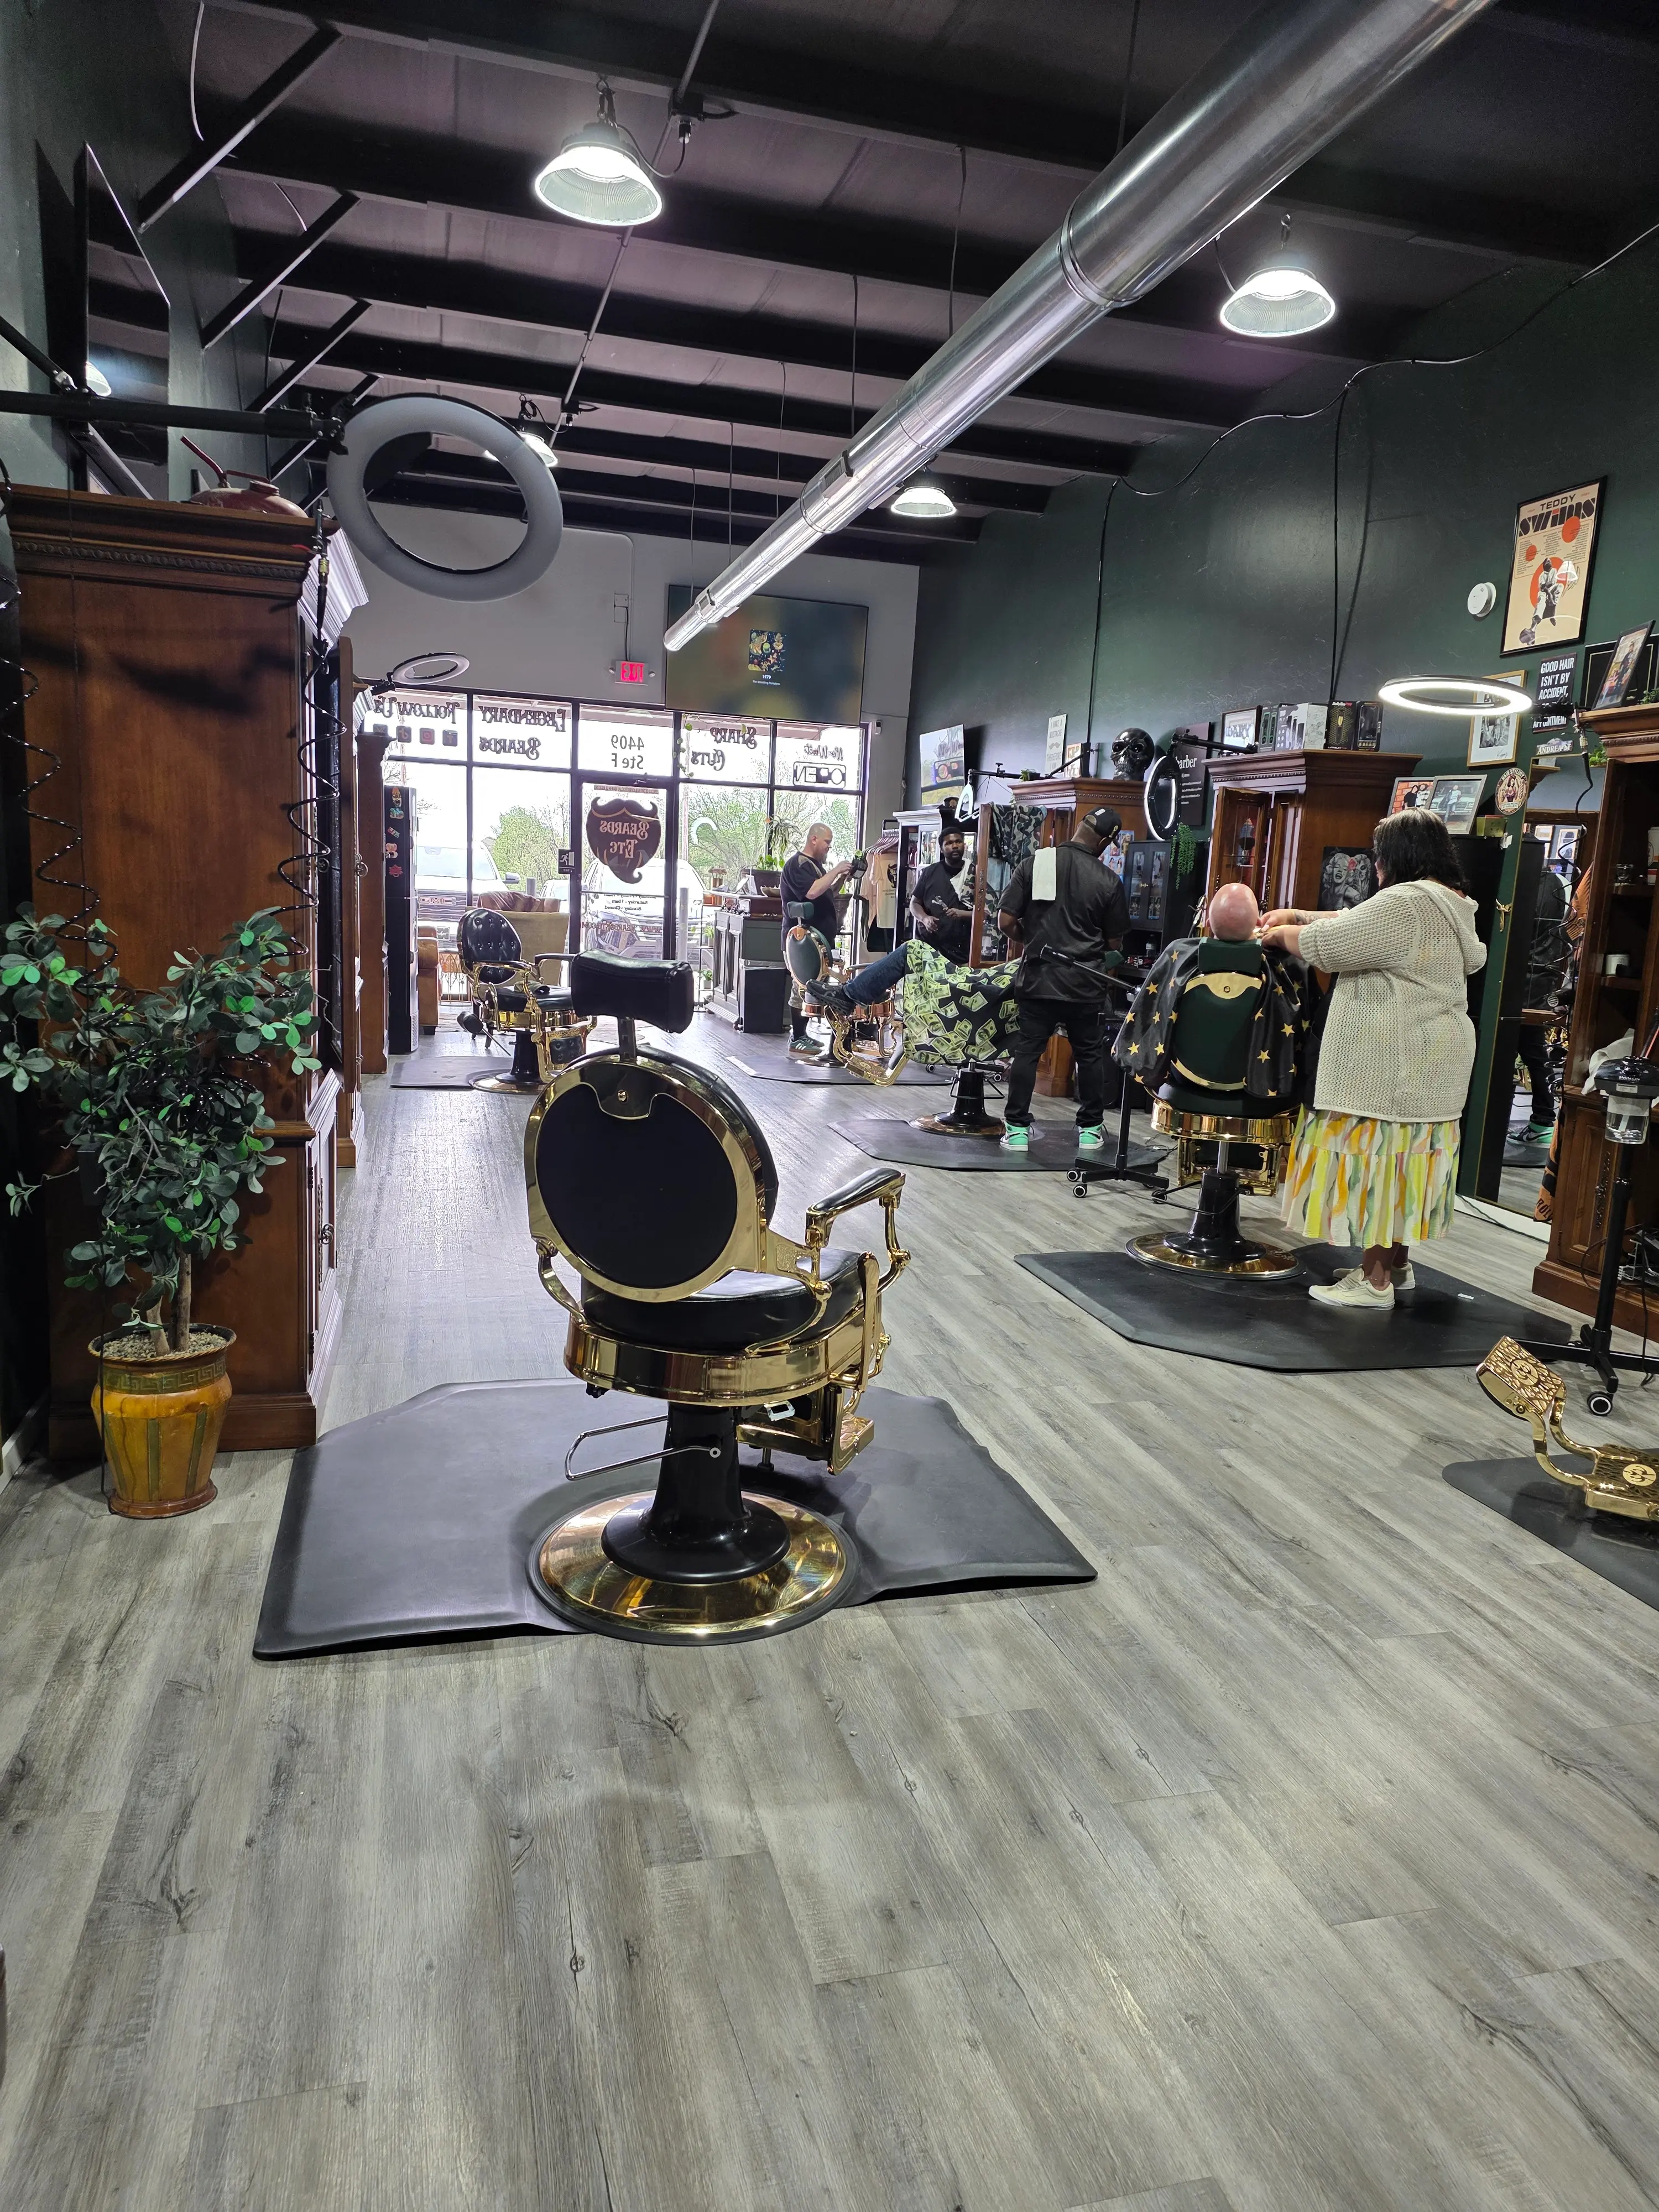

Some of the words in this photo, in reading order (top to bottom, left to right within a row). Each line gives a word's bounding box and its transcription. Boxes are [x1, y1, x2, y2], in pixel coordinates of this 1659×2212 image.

[1540, 493, 1576, 511] TEDDY
[621, 661, 644, 682] EXIT
[1540, 661, 1558, 674] GOOD
[1559, 657, 1574, 671] HAIR
[1540, 673, 1559, 687] ISN'T
[1559, 672, 1571, 684] BY
[1501, 771, 1510, 781] HAIR
[1510, 769, 1525, 778] STYLIST
[419, 896, 457, 905] GMC
